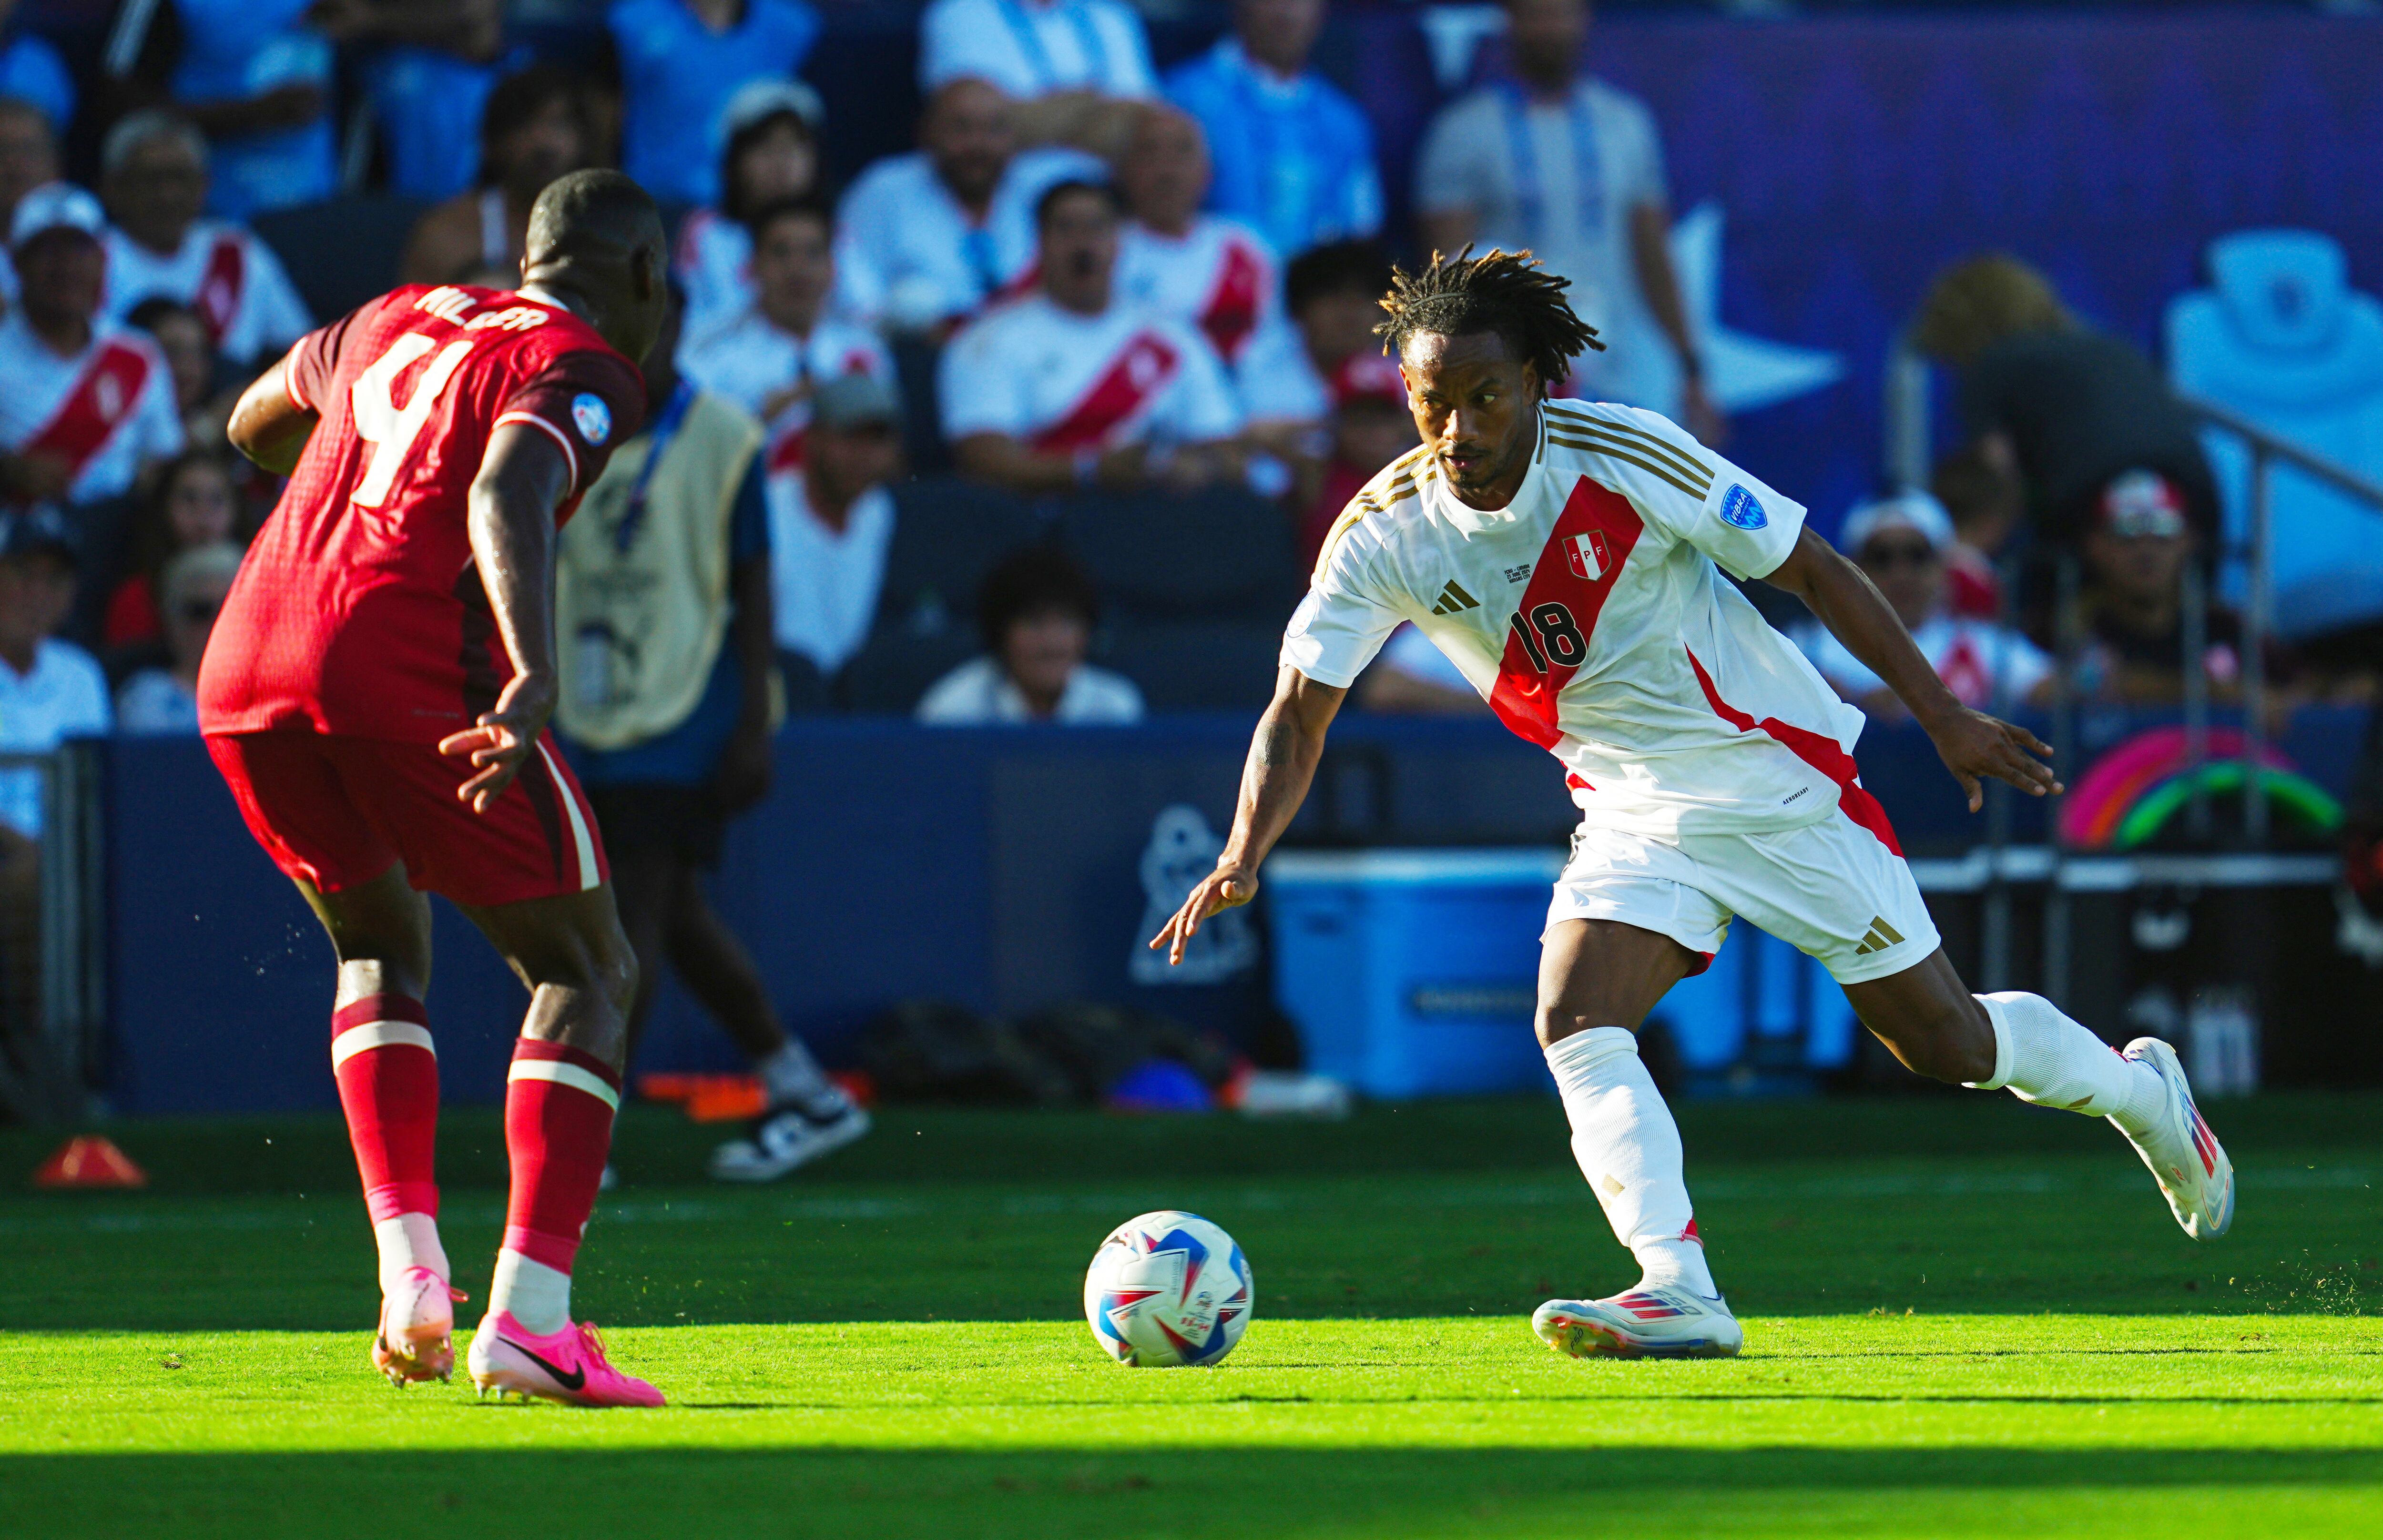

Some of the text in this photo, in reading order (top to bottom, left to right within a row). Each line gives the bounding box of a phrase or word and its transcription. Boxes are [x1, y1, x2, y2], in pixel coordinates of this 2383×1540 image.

[413, 285, 550, 331] MILLER
[349, 332, 474, 507] 4
[1731, 493, 1747, 520] VIBRA
[1509, 602, 1588, 674] 18
[1782, 786, 1809, 805] AEROREADY
[1570, 1327, 1583, 1351] F50
